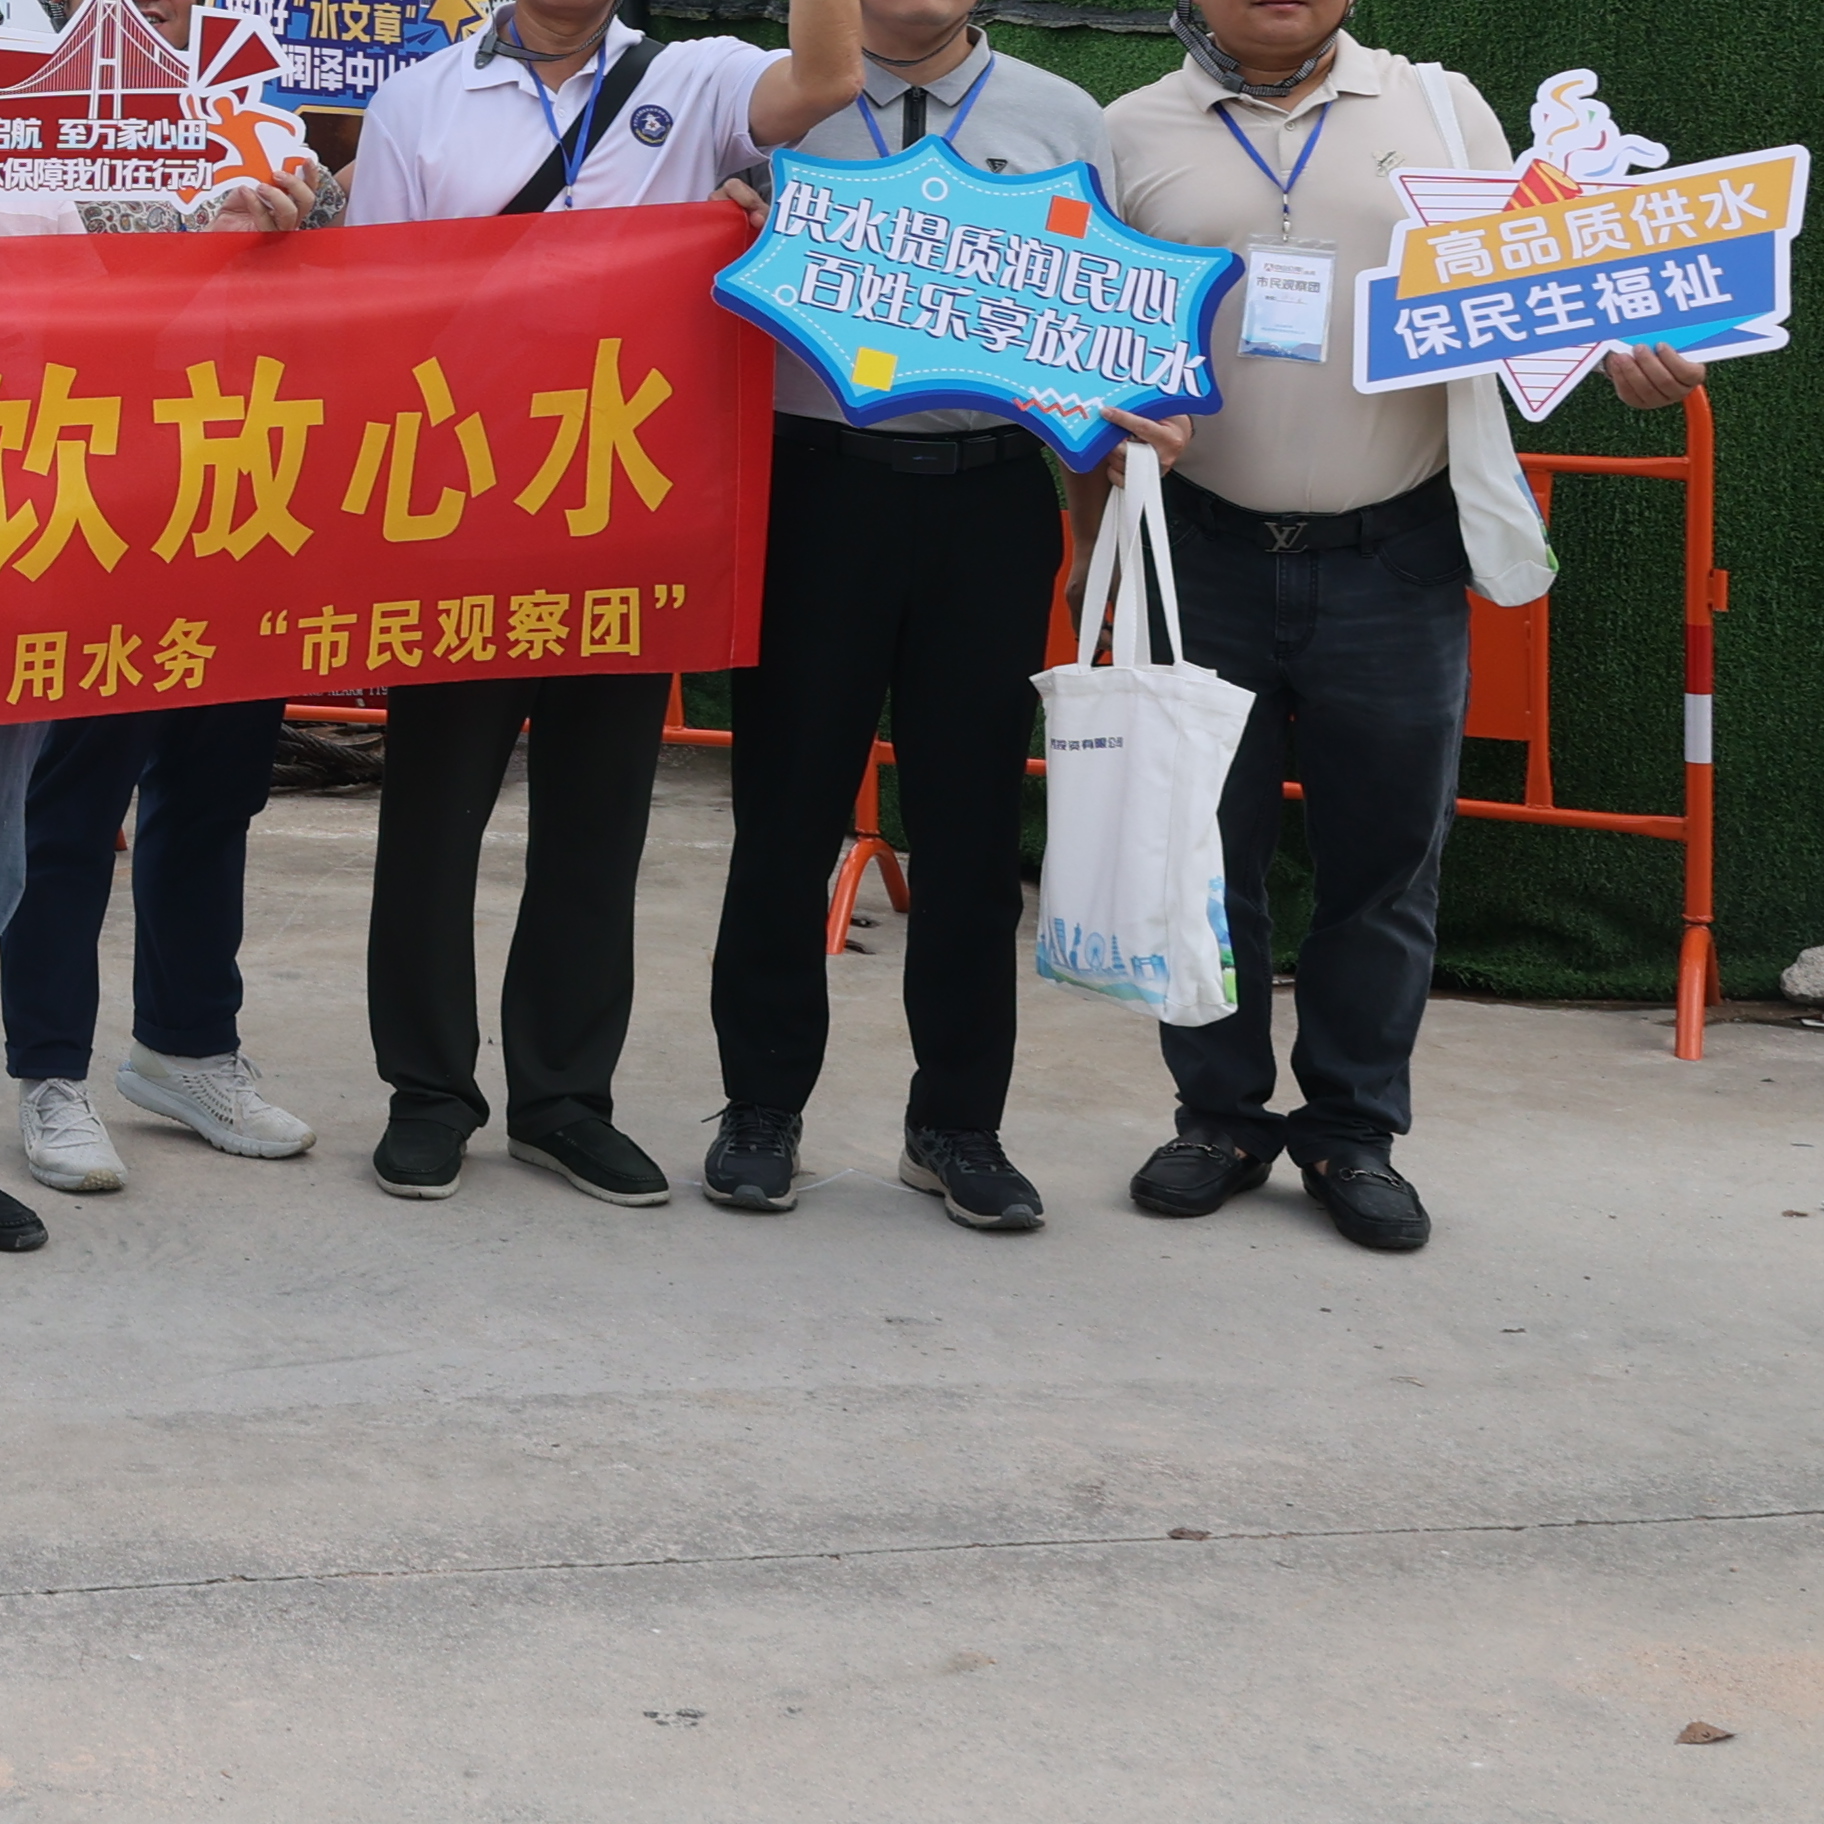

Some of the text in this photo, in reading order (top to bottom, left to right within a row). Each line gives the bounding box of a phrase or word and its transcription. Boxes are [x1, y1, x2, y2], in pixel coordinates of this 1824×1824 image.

[56, 116, 207, 151] 至万家心田
[774, 180, 1180, 327] 供水提质润民心
[1426, 177, 1769, 285] 高品质供水
[799, 251, 1208, 398] 百姓乐享放心水
[1256, 276, 1321, 293] 市民观察团
[1393, 256, 1736, 360] 保民生福祉
